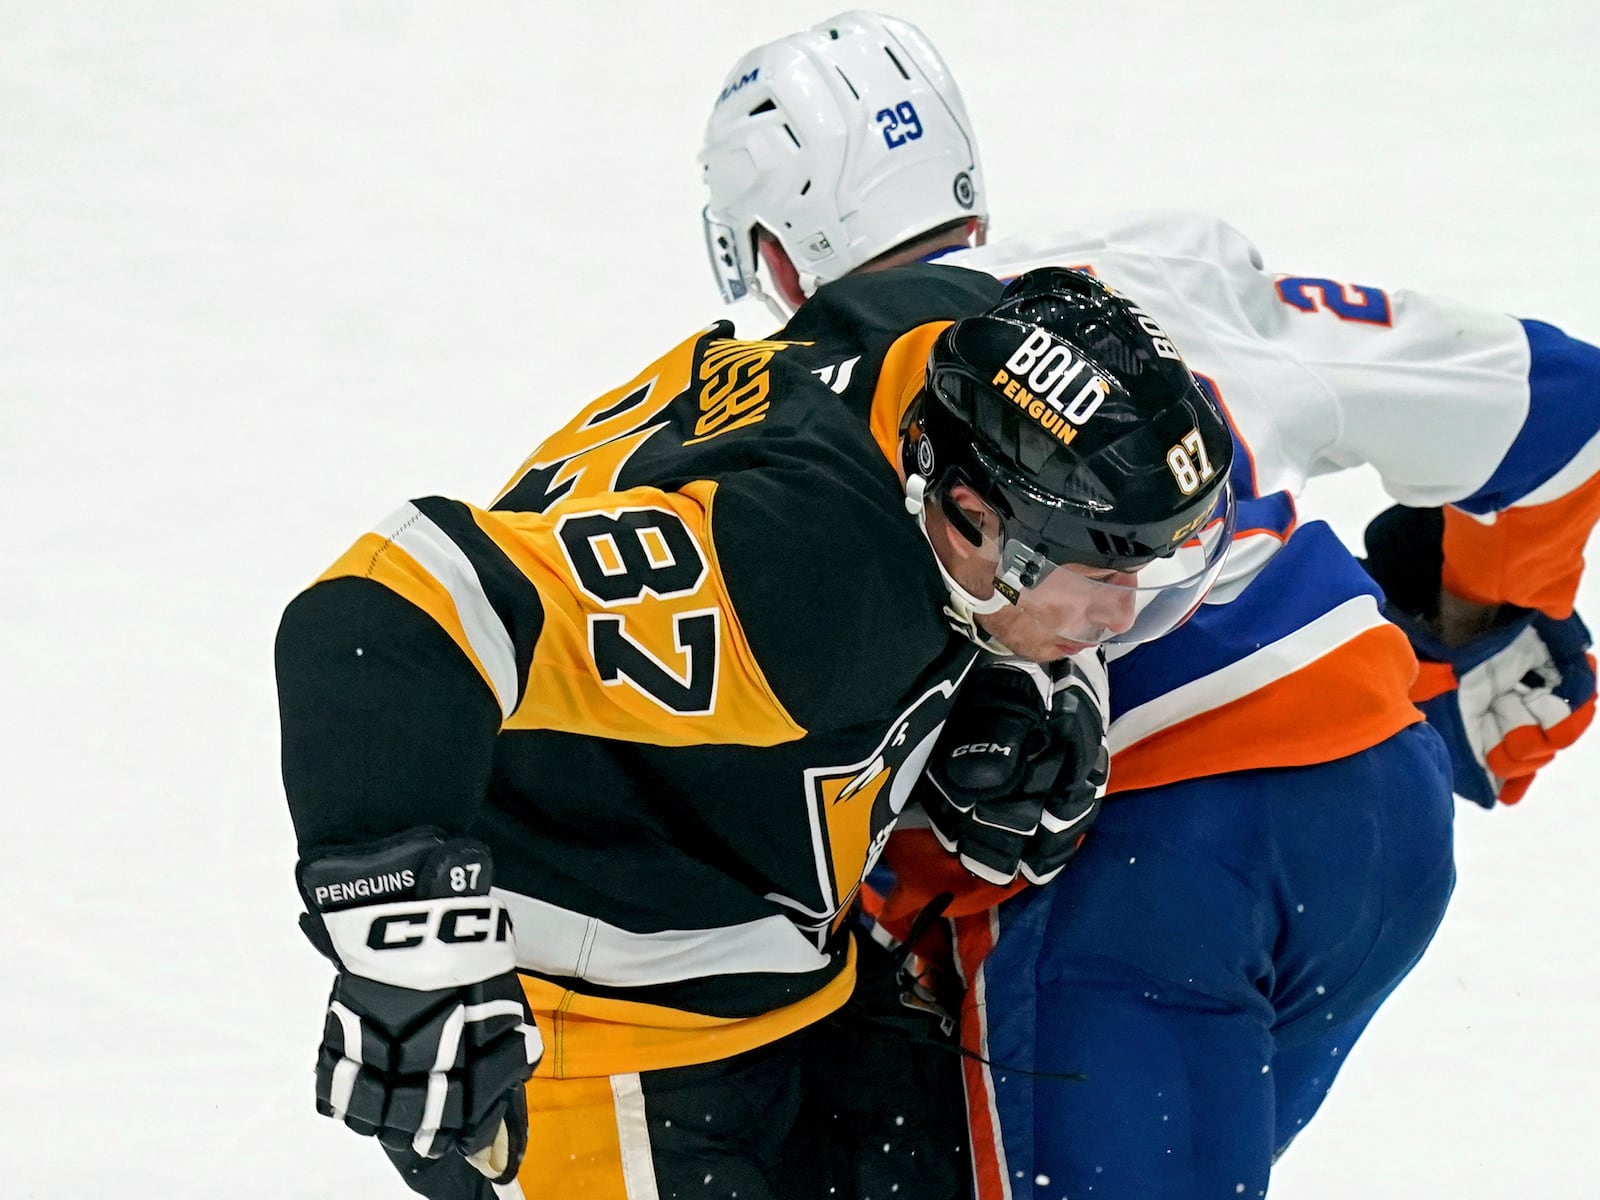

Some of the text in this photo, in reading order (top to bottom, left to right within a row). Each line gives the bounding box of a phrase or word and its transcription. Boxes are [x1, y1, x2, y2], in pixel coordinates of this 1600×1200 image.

[876, 100, 923, 150] 29
[992, 369, 1078, 445] PENGUIN
[1005, 327, 1110, 425] BOLD
[1166, 427, 1215, 496] 87
[553, 505, 720, 716] 87
[952, 743, 1011, 757] CCM
[315, 863, 482, 904] PENGUINS 87
